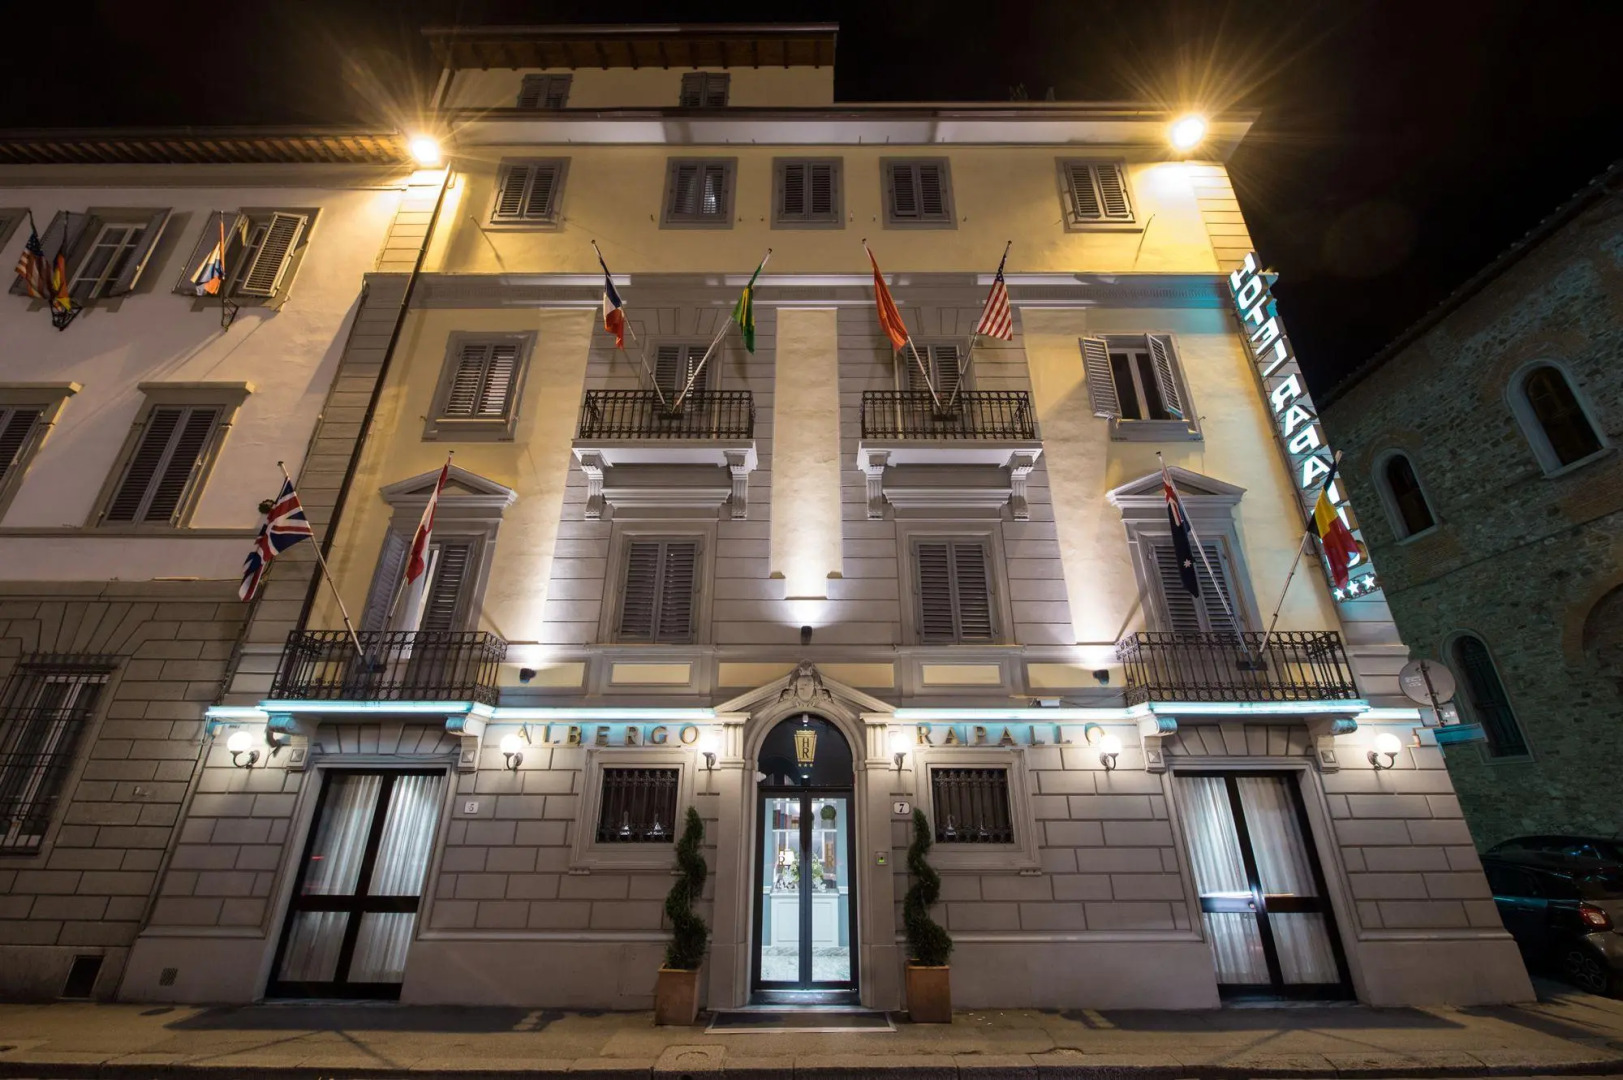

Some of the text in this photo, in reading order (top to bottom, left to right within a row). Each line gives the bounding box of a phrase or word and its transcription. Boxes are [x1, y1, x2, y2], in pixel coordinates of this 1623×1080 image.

[516, 722, 700, 746] ALBERGO
[468, 803, 475, 812] 5
[899, 803, 905, 813] 7
